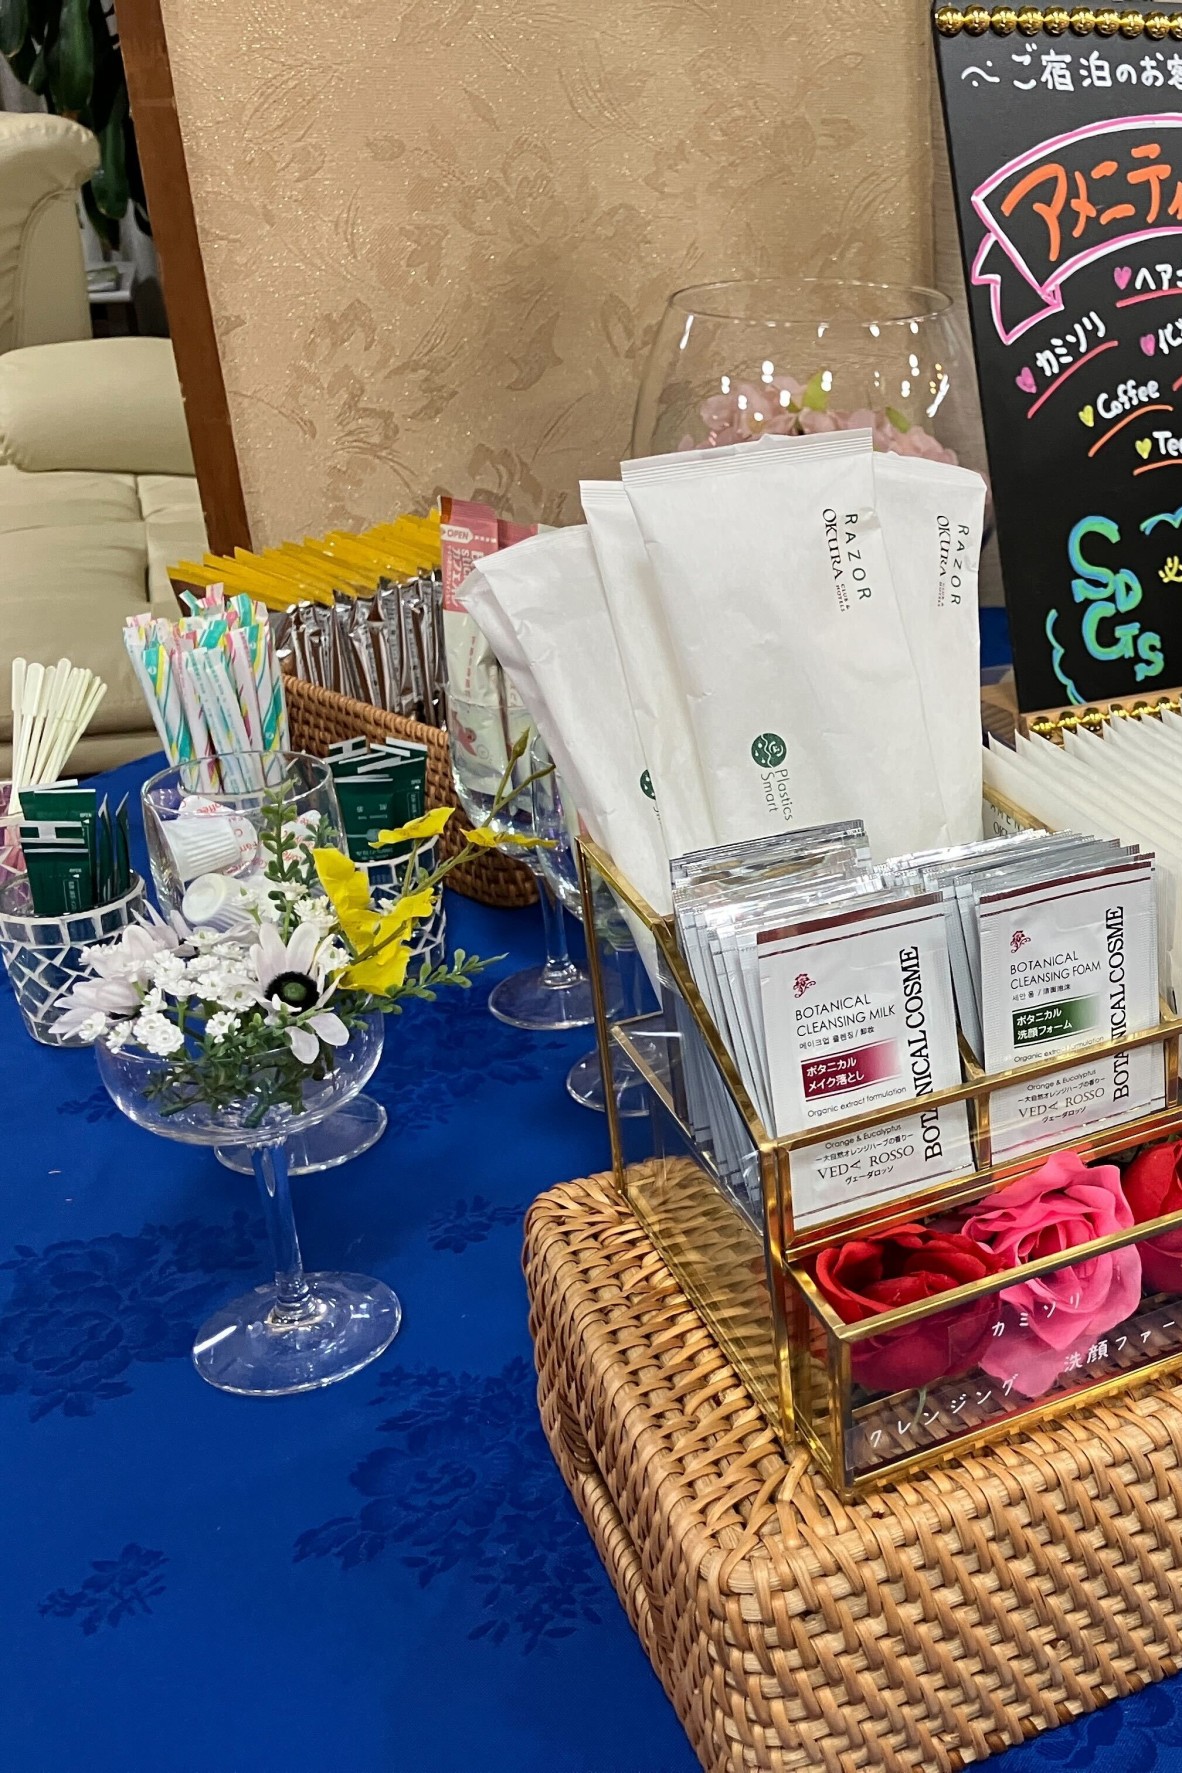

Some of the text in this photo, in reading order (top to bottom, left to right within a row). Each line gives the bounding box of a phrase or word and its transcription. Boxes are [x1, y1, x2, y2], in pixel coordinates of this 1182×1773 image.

[1036, 311, 1106, 376] カミソリ
[1097, 379, 1160, 419] Coffee
[447, 529, 469, 540] OPEN
[822, 508, 843, 580] OKURA
[936, 515, 951, 577] OKURA
[844, 513, 872, 600] RAZOR
[950, 524, 970, 605] RAZOR
[760, 771, 779, 813] Smart
[775, 768, 793, 821] Plastics
[1106, 906, 1125, 983] COSME
[1010, 950, 1079, 975] BOTANICAL
[1010, 960, 1102, 990] CLEANSING FOAM
[899, 945, 925, 1029] COSME
[795, 994, 871, 1021] BOTANICAL
[796, 1004, 896, 1037] CLEANSING MILK
[1016, 1007, 1063, 1027] ボタニカル
[1017, 1020, 1073, 1040] 洗顔フォーム
[806, 1056, 857, 1077] ボタニカル
[1014, 1052, 1042, 1063] Organic
[808, 1070, 865, 1092] メイク落とし
[1027, 1081, 1055, 1091] Orange
[1062, 1069, 1096, 1084] Eucalyptus
[807, 1086, 907, 1118] Organic extract formulation
[1065, 1087, 1105, 1108] ROSSO
[825, 1137, 855, 1150] Orange
[863, 1123, 902, 1141] Eucalyptus
[869, 1144, 915, 1168] ROSSO
[991, 1292, 1082, 1337] カミソリ
[870, 1373, 1019, 1448] クレンジング
